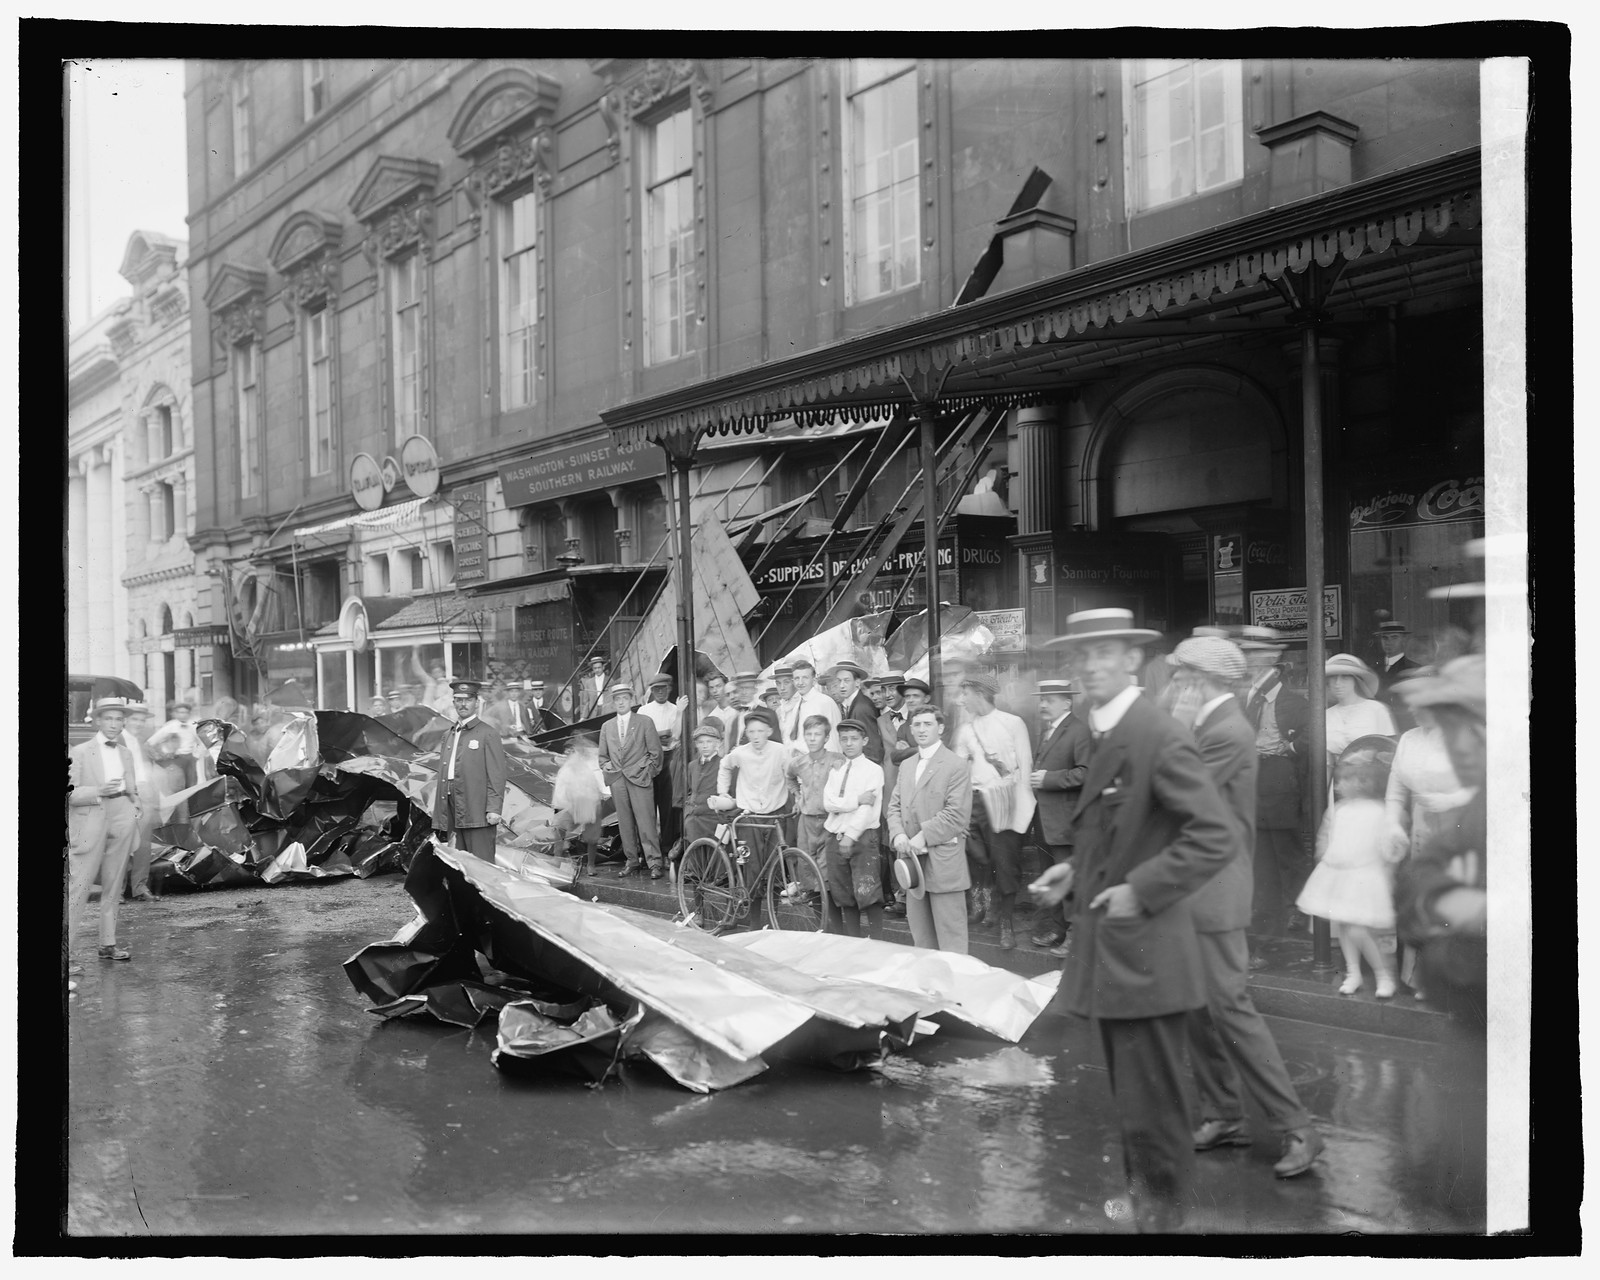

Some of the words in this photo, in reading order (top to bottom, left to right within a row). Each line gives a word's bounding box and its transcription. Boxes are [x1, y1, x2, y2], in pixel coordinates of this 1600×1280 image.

[504, 447, 612, 483] WASHINGTON-SUNSET
[529, 472, 583, 494] SOUTHERN
[1350, 491, 1415, 527] Delicious
[1416, 479, 1484, 521] Coc
[963, 548, 1001, 564] DRUGS
[756, 562, 824, 584] -SUPPLIES
[1061, 564, 1110, 580] Sanitary
[1113, 564, 1160, 579] Fountain
[1282, 604, 1308, 613] POPULA
[1289, 591, 1335, 606] There
